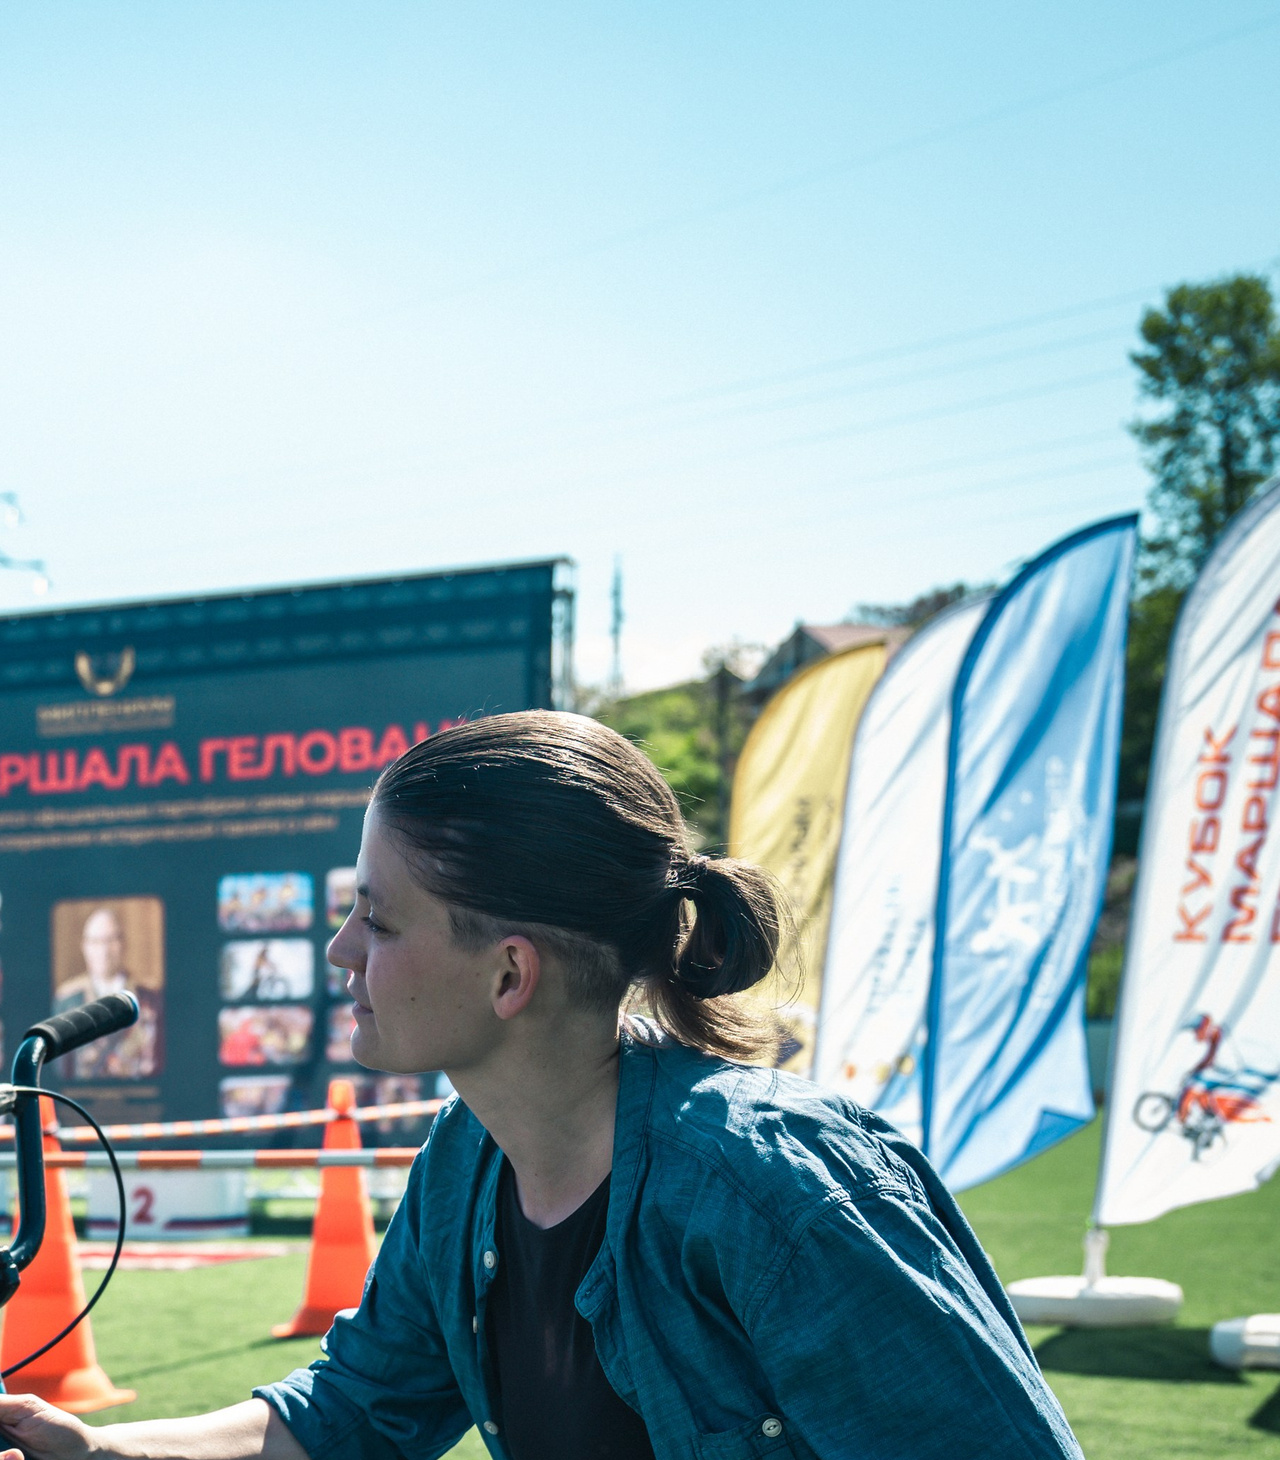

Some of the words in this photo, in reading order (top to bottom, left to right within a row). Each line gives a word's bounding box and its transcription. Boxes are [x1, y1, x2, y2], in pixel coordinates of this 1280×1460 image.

[198, 719, 466, 783] ГЕЛОВА
[1173, 723, 1238, 943] КУБОК
[132, 1186, 155, 1225] 2
